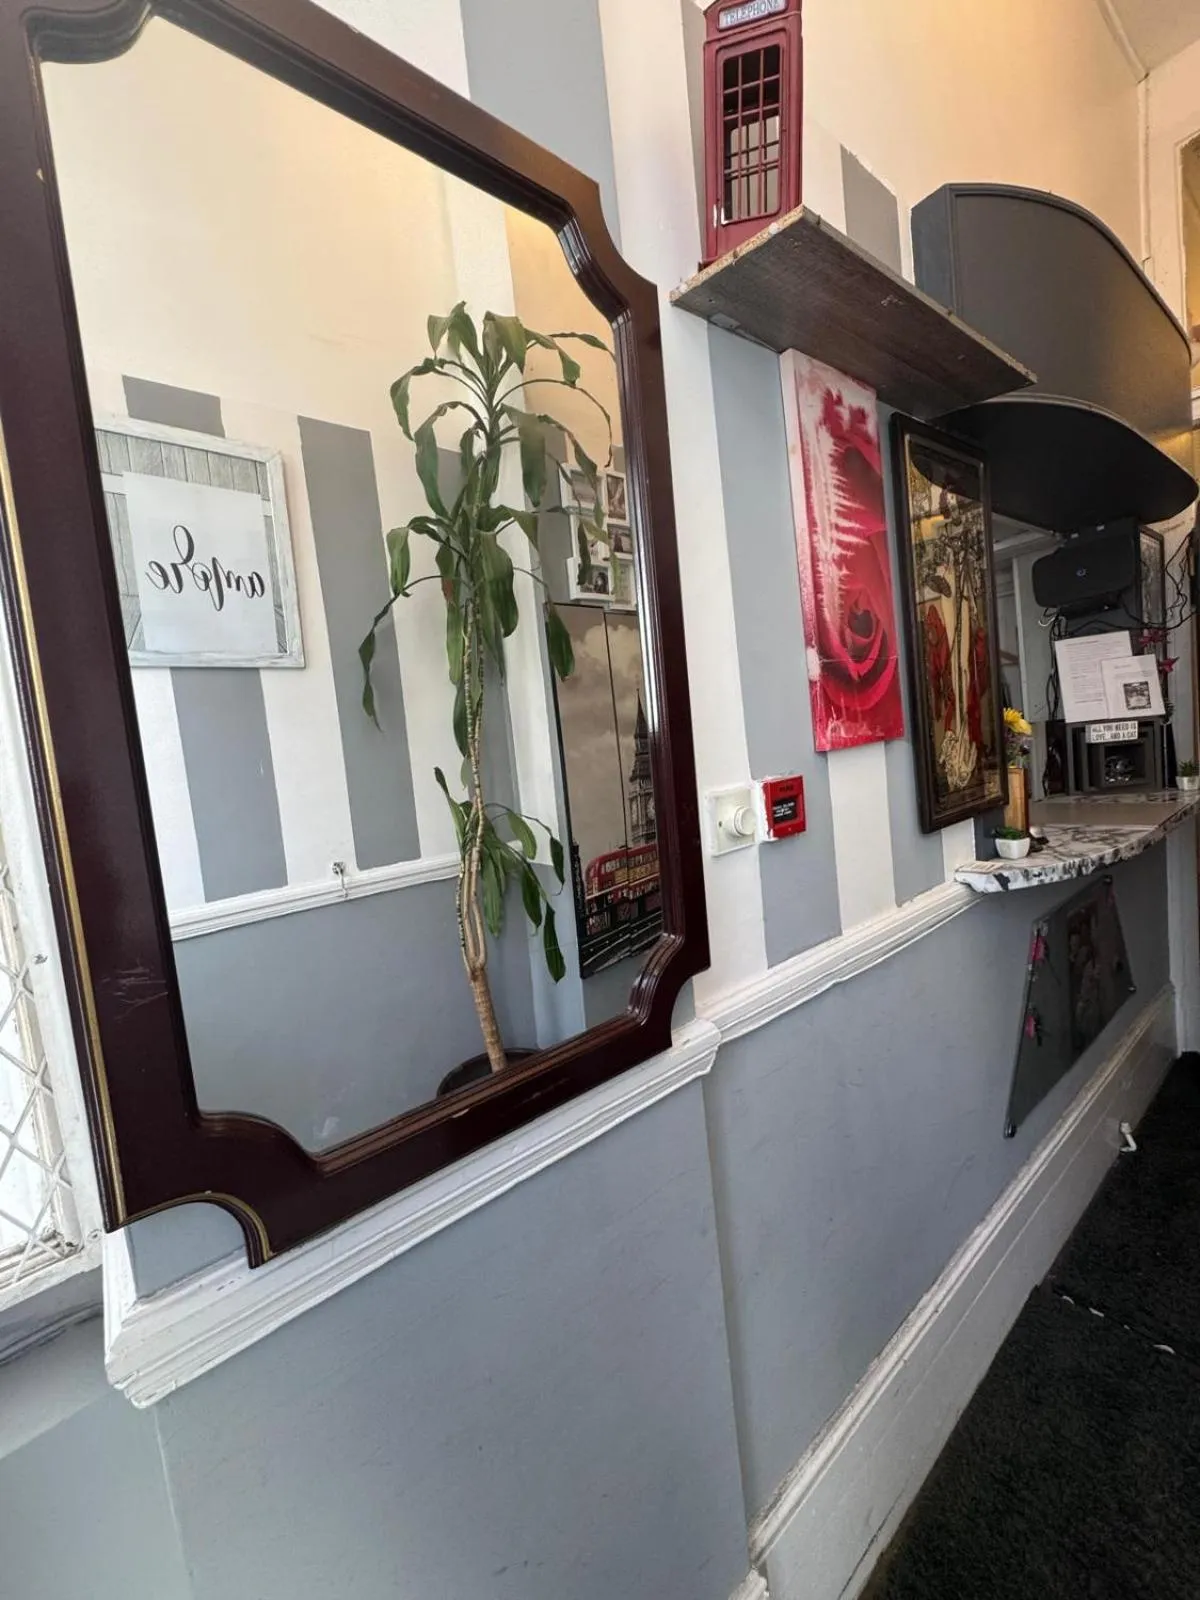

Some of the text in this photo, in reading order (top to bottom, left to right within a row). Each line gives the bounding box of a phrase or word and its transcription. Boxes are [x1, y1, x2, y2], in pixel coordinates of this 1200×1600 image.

[724, 0, 780, 24] TELEPHONE
[1130, 722, 1137, 730] IS
[1126, 730, 1137, 738] CAT
